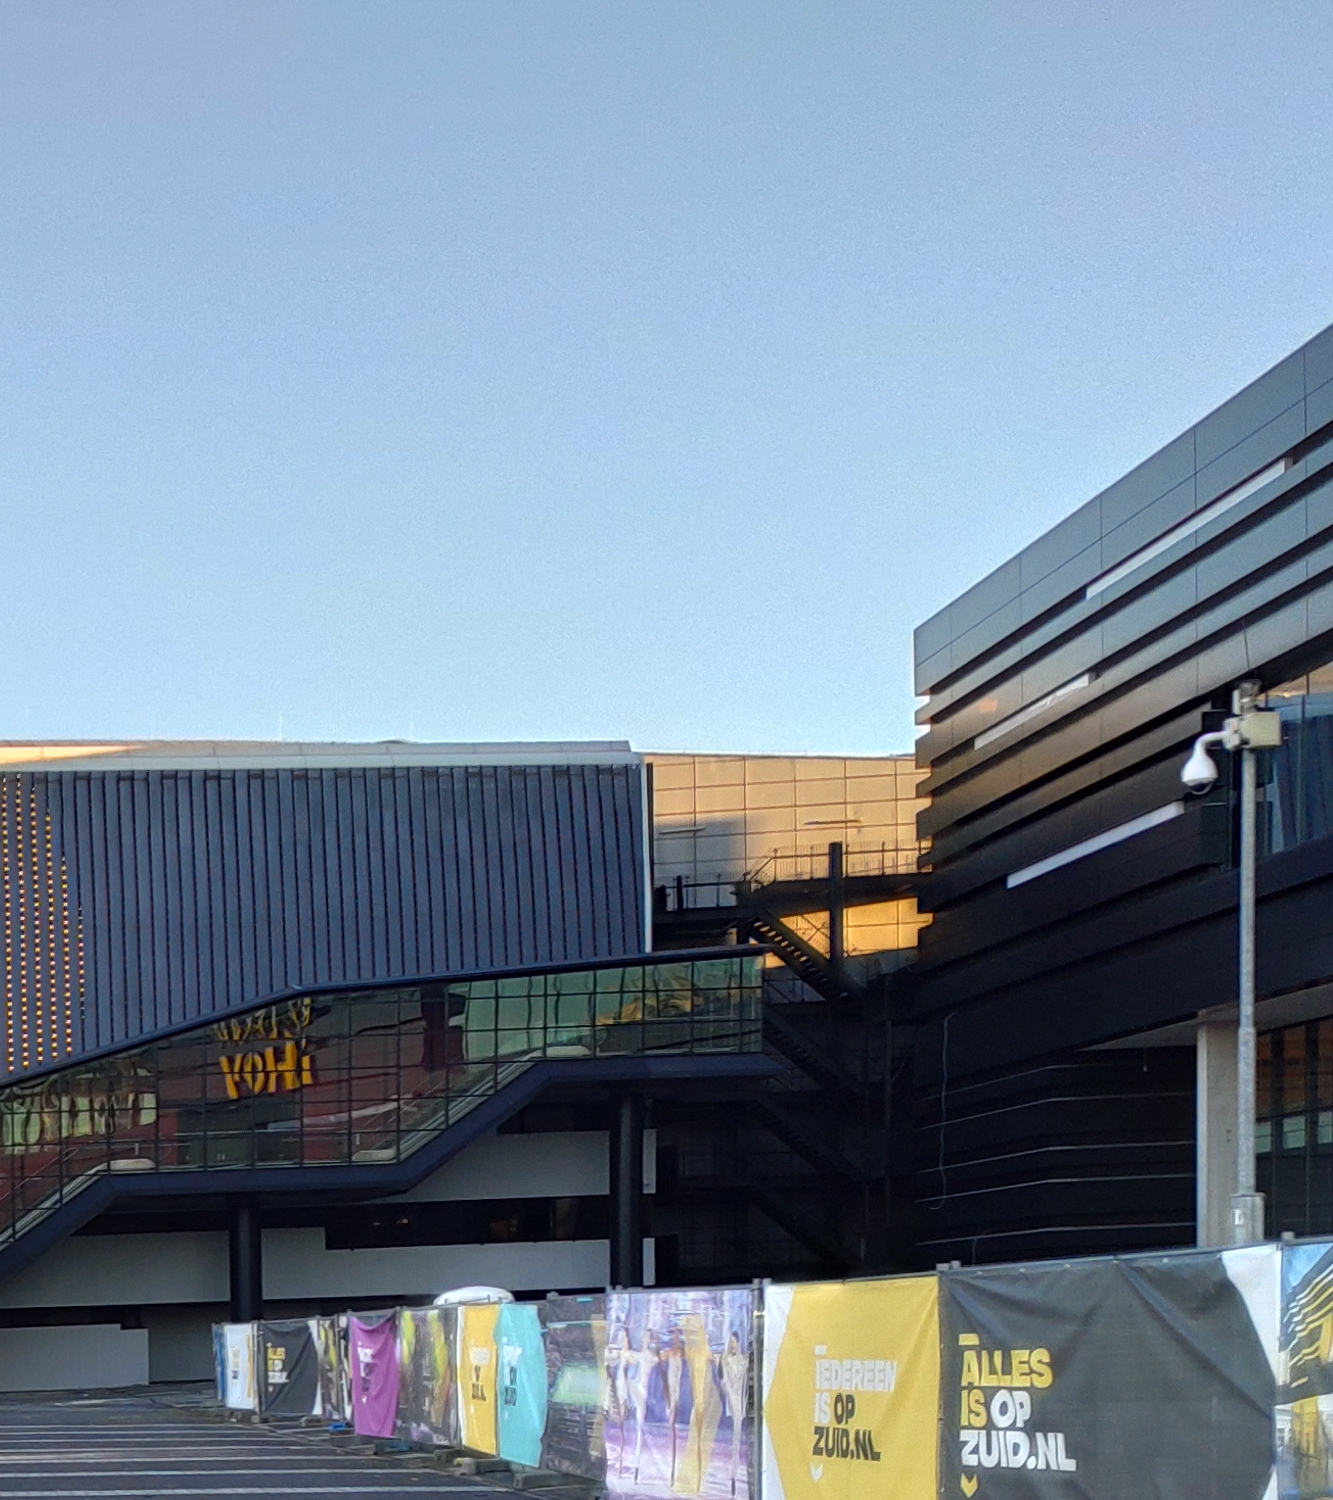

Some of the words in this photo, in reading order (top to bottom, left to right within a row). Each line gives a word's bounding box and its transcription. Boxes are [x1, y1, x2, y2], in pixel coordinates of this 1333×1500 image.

[814, 1357, 898, 1392] IEDEREEN
[960, 1347, 1054, 1388] ALLES
[813, 1392, 831, 1424] IS
[833, 1392, 856, 1425] OP
[960, 1389, 988, 1428] IS
[989, 1389, 1032, 1428] OP
[811, 1425, 882, 1462] ZUID.NL
[959, 1429, 1077, 1472] ZUID.NL
